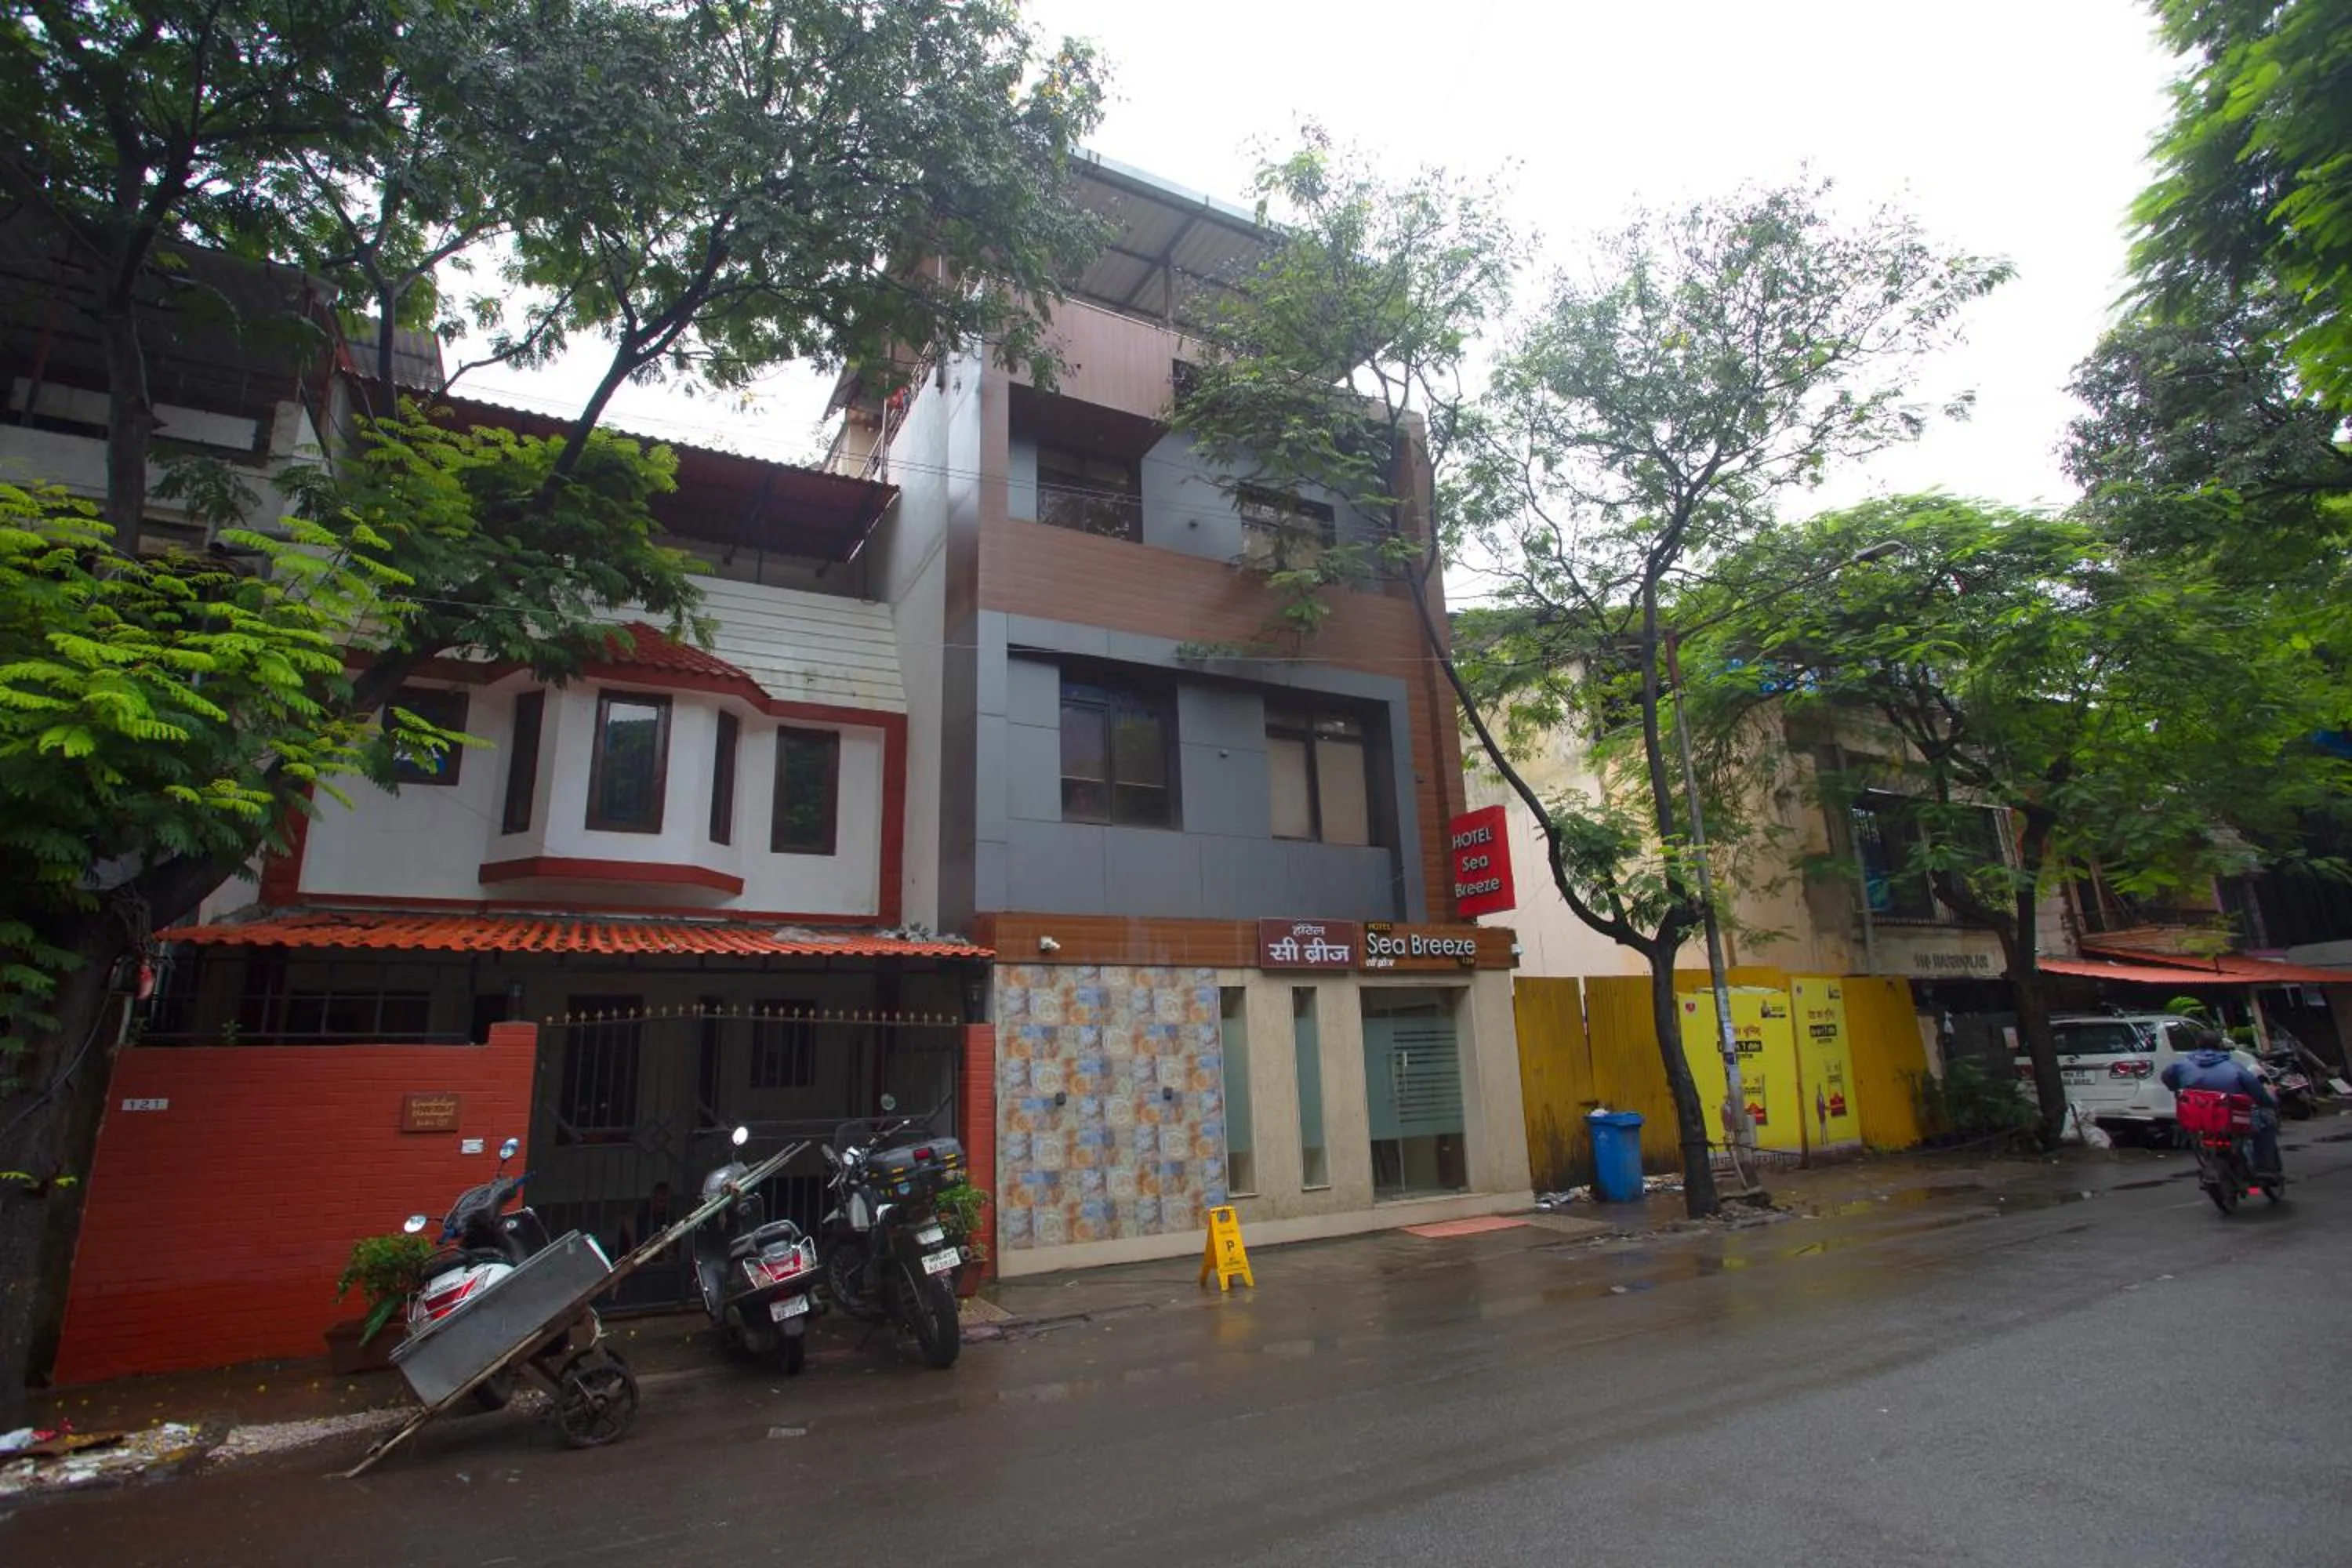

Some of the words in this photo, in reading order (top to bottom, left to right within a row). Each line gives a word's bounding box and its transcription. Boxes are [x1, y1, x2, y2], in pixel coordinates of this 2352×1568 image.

[1452, 827, 1493, 849] HOTEL
[1462, 855, 1489, 873] Sea
[1455, 877, 1500, 898] Breeze
[1268, 936, 1299, 961] सी
[1302, 937, 1350, 964] ब्रीज
[1367, 932, 1406, 954] Sea
[1410, 934, 1475, 955] Breeze
[130, 1100, 158, 1109] 121
[1225, 1240, 1235, 1252] P
